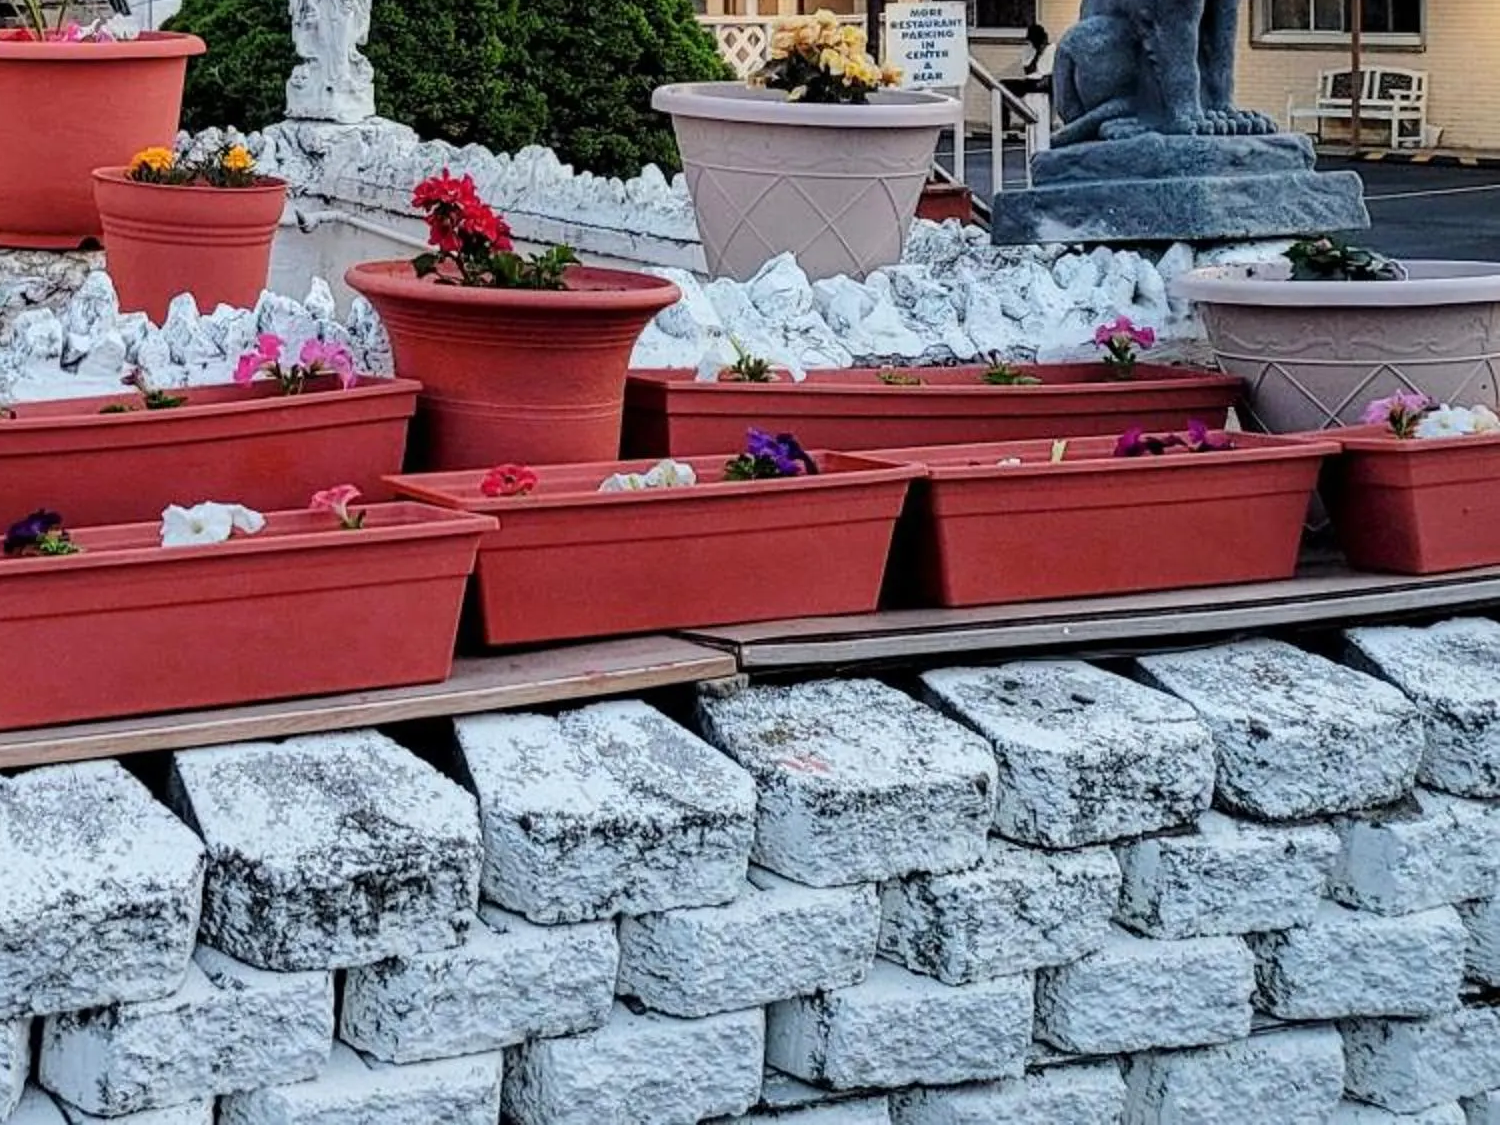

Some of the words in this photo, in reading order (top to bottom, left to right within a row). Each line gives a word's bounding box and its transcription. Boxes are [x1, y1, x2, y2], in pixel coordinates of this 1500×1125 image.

[910, 8, 942, 17] MORE
[890, 19, 962, 29] RESTAURANT
[901, 30, 954, 39] PARKING
[921, 41, 935, 49] IN
[905, 50, 949, 59] CENTER
[913, 72, 943, 81] REAR
